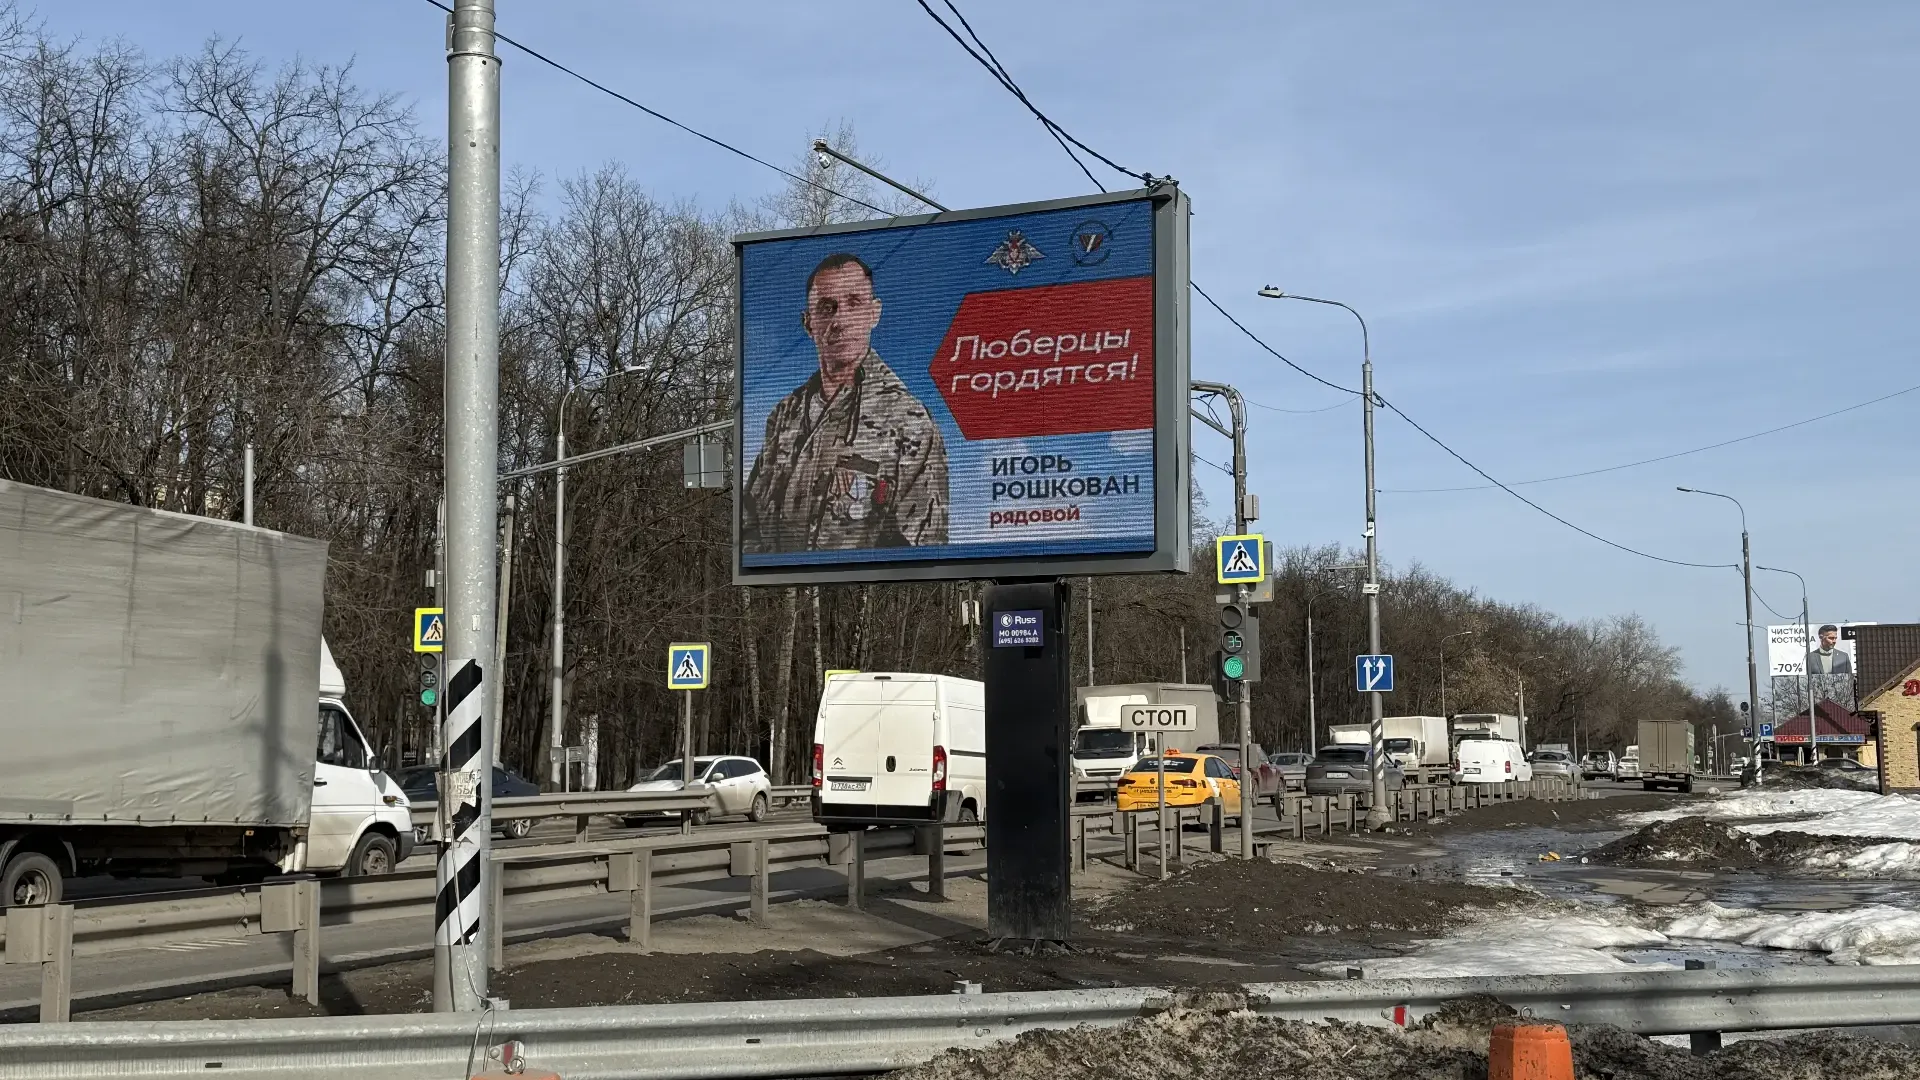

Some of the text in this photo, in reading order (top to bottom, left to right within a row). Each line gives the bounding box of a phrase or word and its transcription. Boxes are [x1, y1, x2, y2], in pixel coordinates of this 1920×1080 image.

[950, 328, 1131, 362] Люберцы
[951, 353, 1139, 399] гордятся!
[992, 454, 1073, 476] ИГОРЬ
[992, 475, 1140, 500] РОШКОВАН
[990, 504, 1080, 528] рядовой
[1014, 616, 1037, 625] Russ
[1227, 636, 1242, 648] 35
[1773, 663, 1803, 673] -70%
[1131, 709, 1187, 726] СТОП
